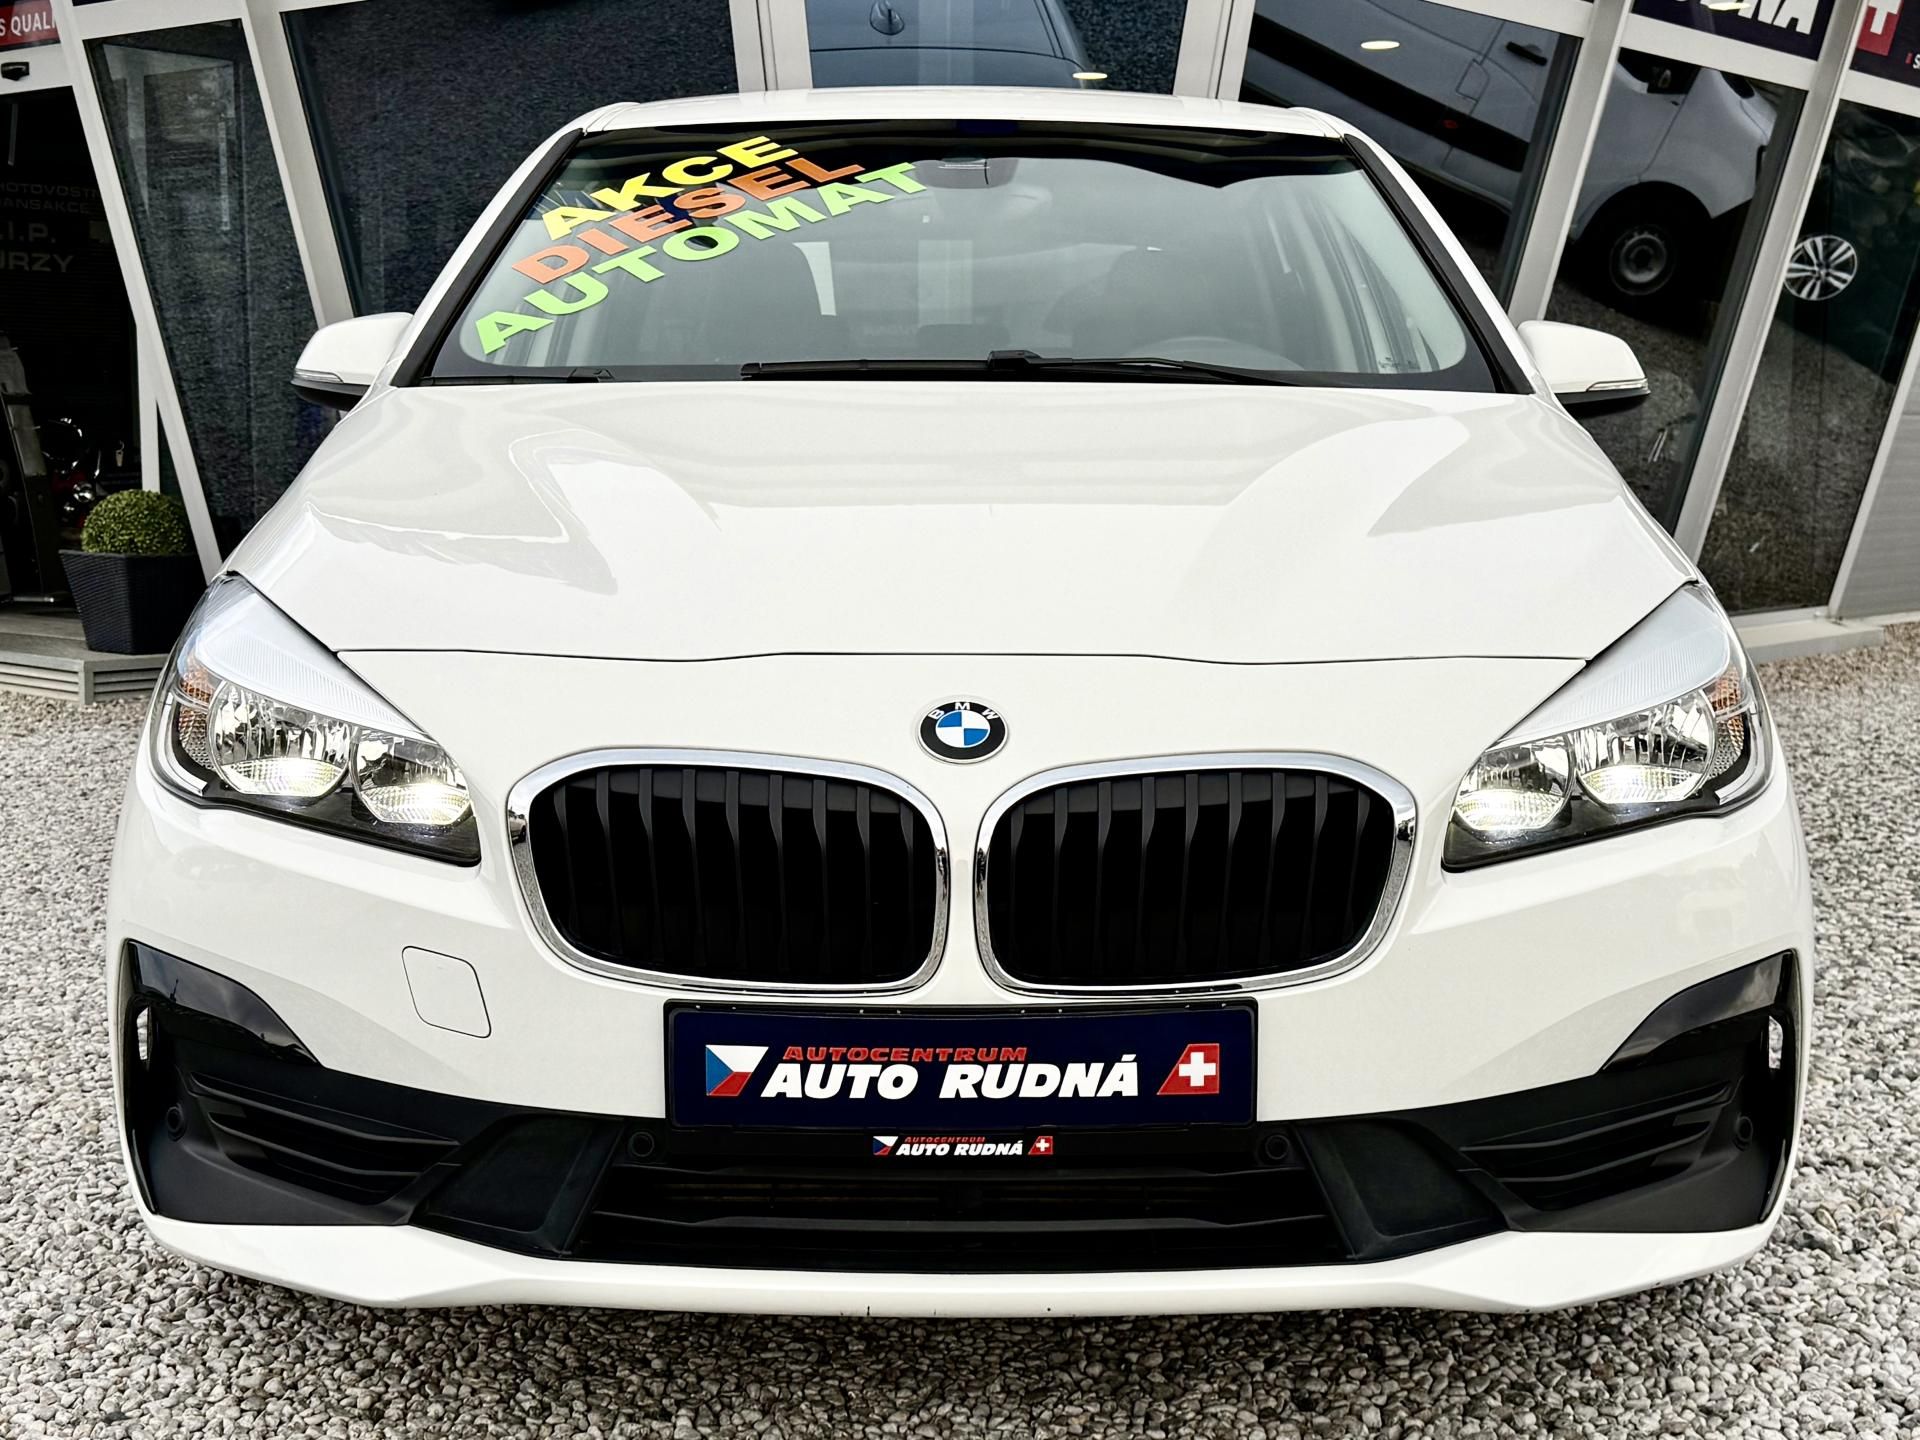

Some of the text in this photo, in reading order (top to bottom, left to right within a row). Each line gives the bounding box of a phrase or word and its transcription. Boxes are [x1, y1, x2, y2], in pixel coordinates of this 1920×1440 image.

[541, 136, 798, 240] AKCE
[0, 197, 89, 214] ANSAKCE
[511, 157, 865, 284] DIESEL
[475, 162, 927, 355] AUTOMAT
[928, 702, 1000, 720] BMW
[783, 1046, 1028, 1062] AUTOCENTRUM
[761, 1053, 1139, 1100] AUTO RUDNÁ
[896, 1140, 1024, 1156] AUTO RUDNÁ
